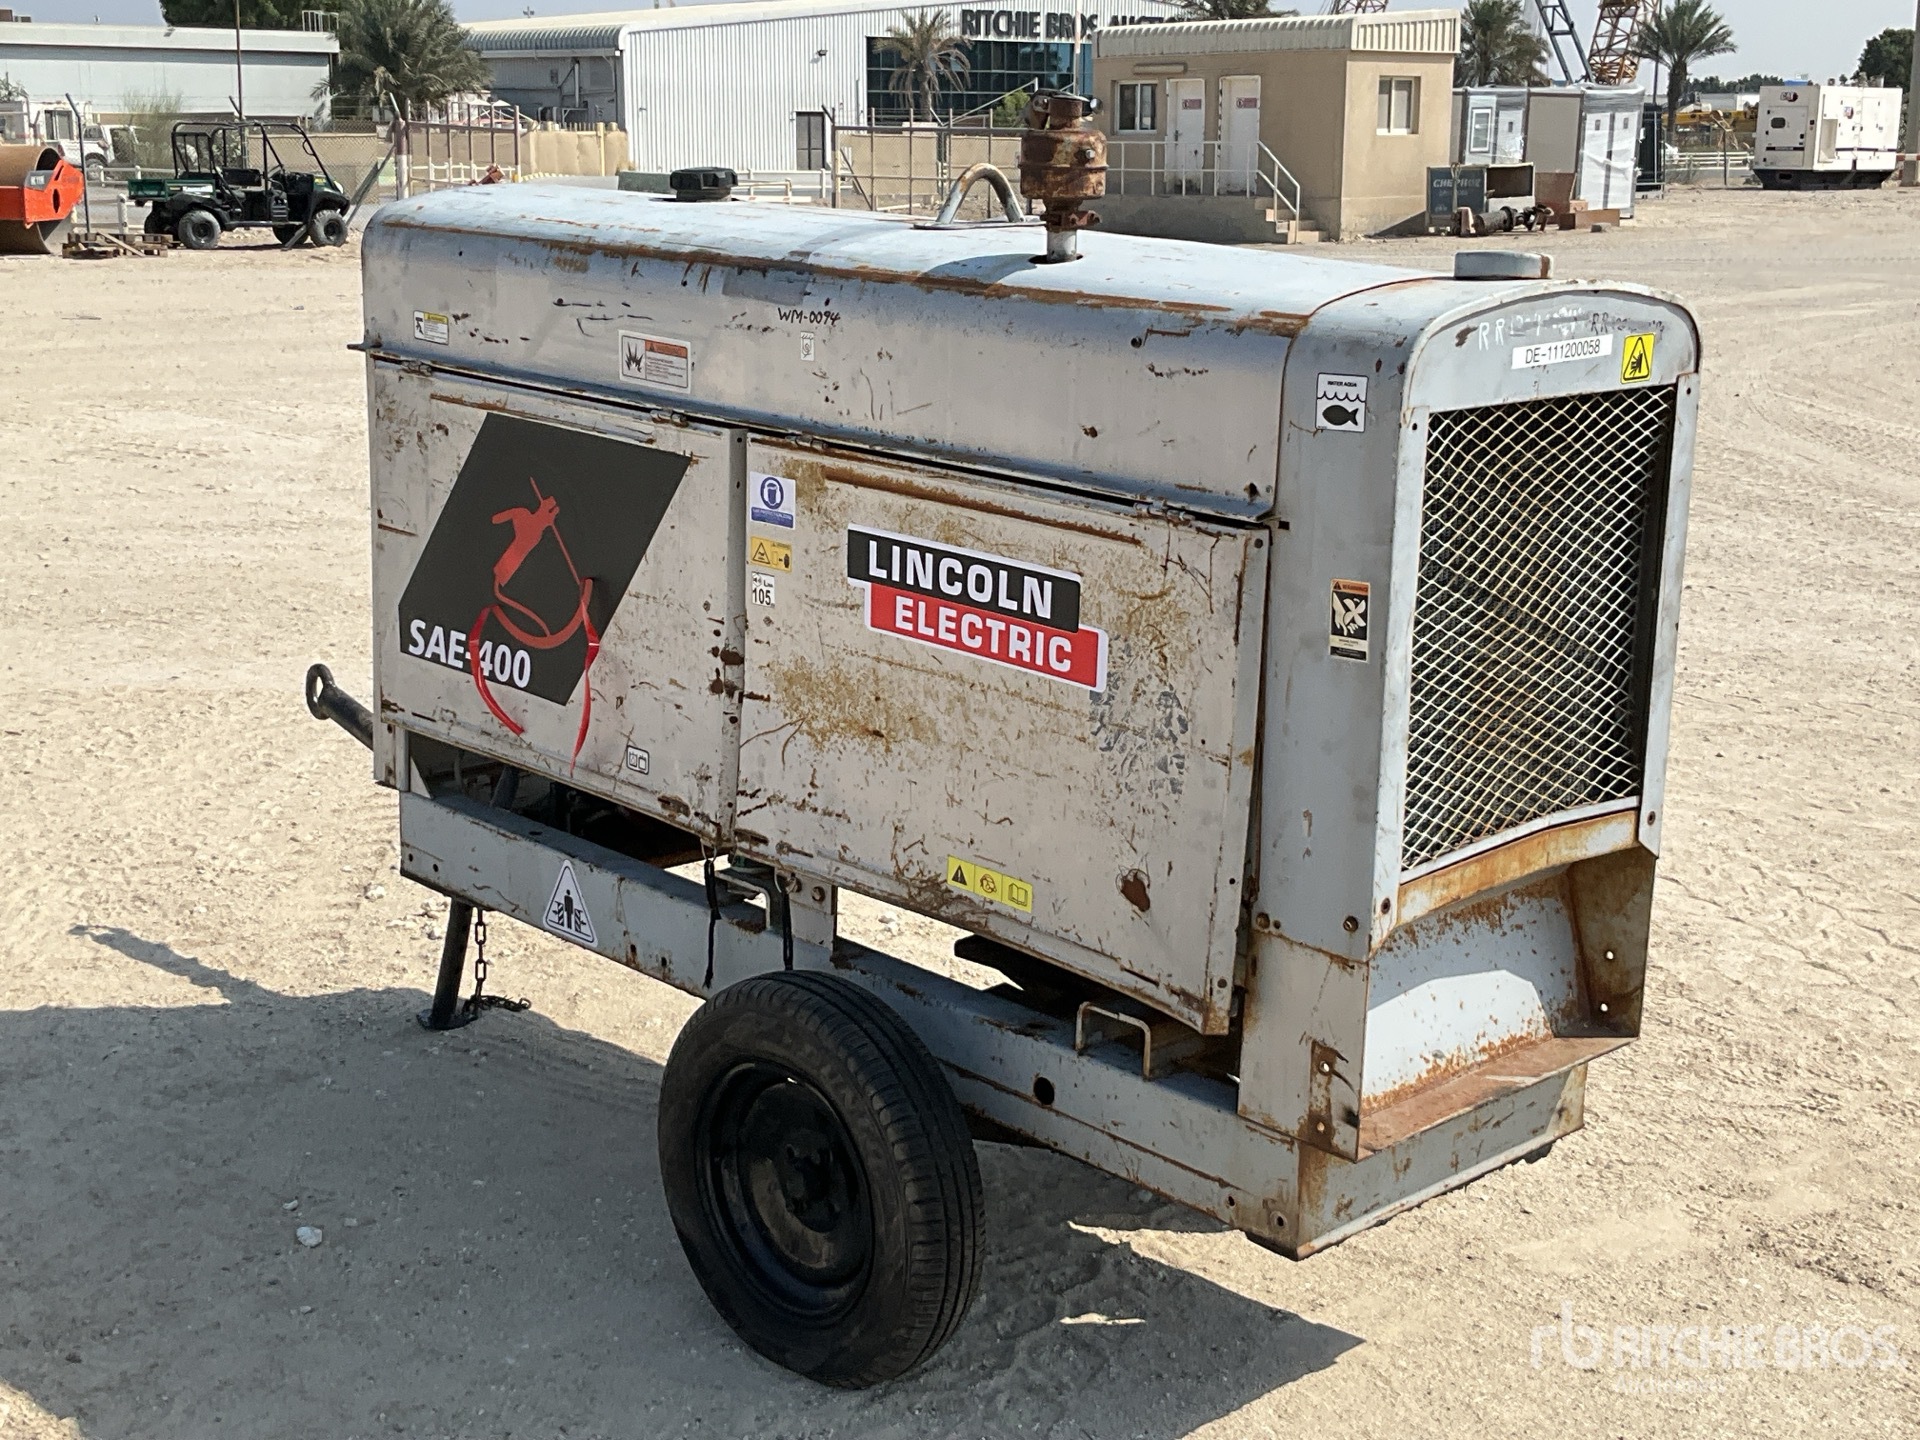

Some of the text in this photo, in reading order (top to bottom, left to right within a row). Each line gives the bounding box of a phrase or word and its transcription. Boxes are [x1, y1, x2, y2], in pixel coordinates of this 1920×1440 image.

[962, 9, 1041, 37] RITCHIE
[778, 307, 841, 326] WM-0094
[1525, 338, 1601, 364] DE-111200058
[868, 540, 1052, 619] LINCOLN
[752, 588, 771, 605] 105
[895, 595, 1071, 673] ELECTRIC
[408, 618, 531, 689] SAE-400
